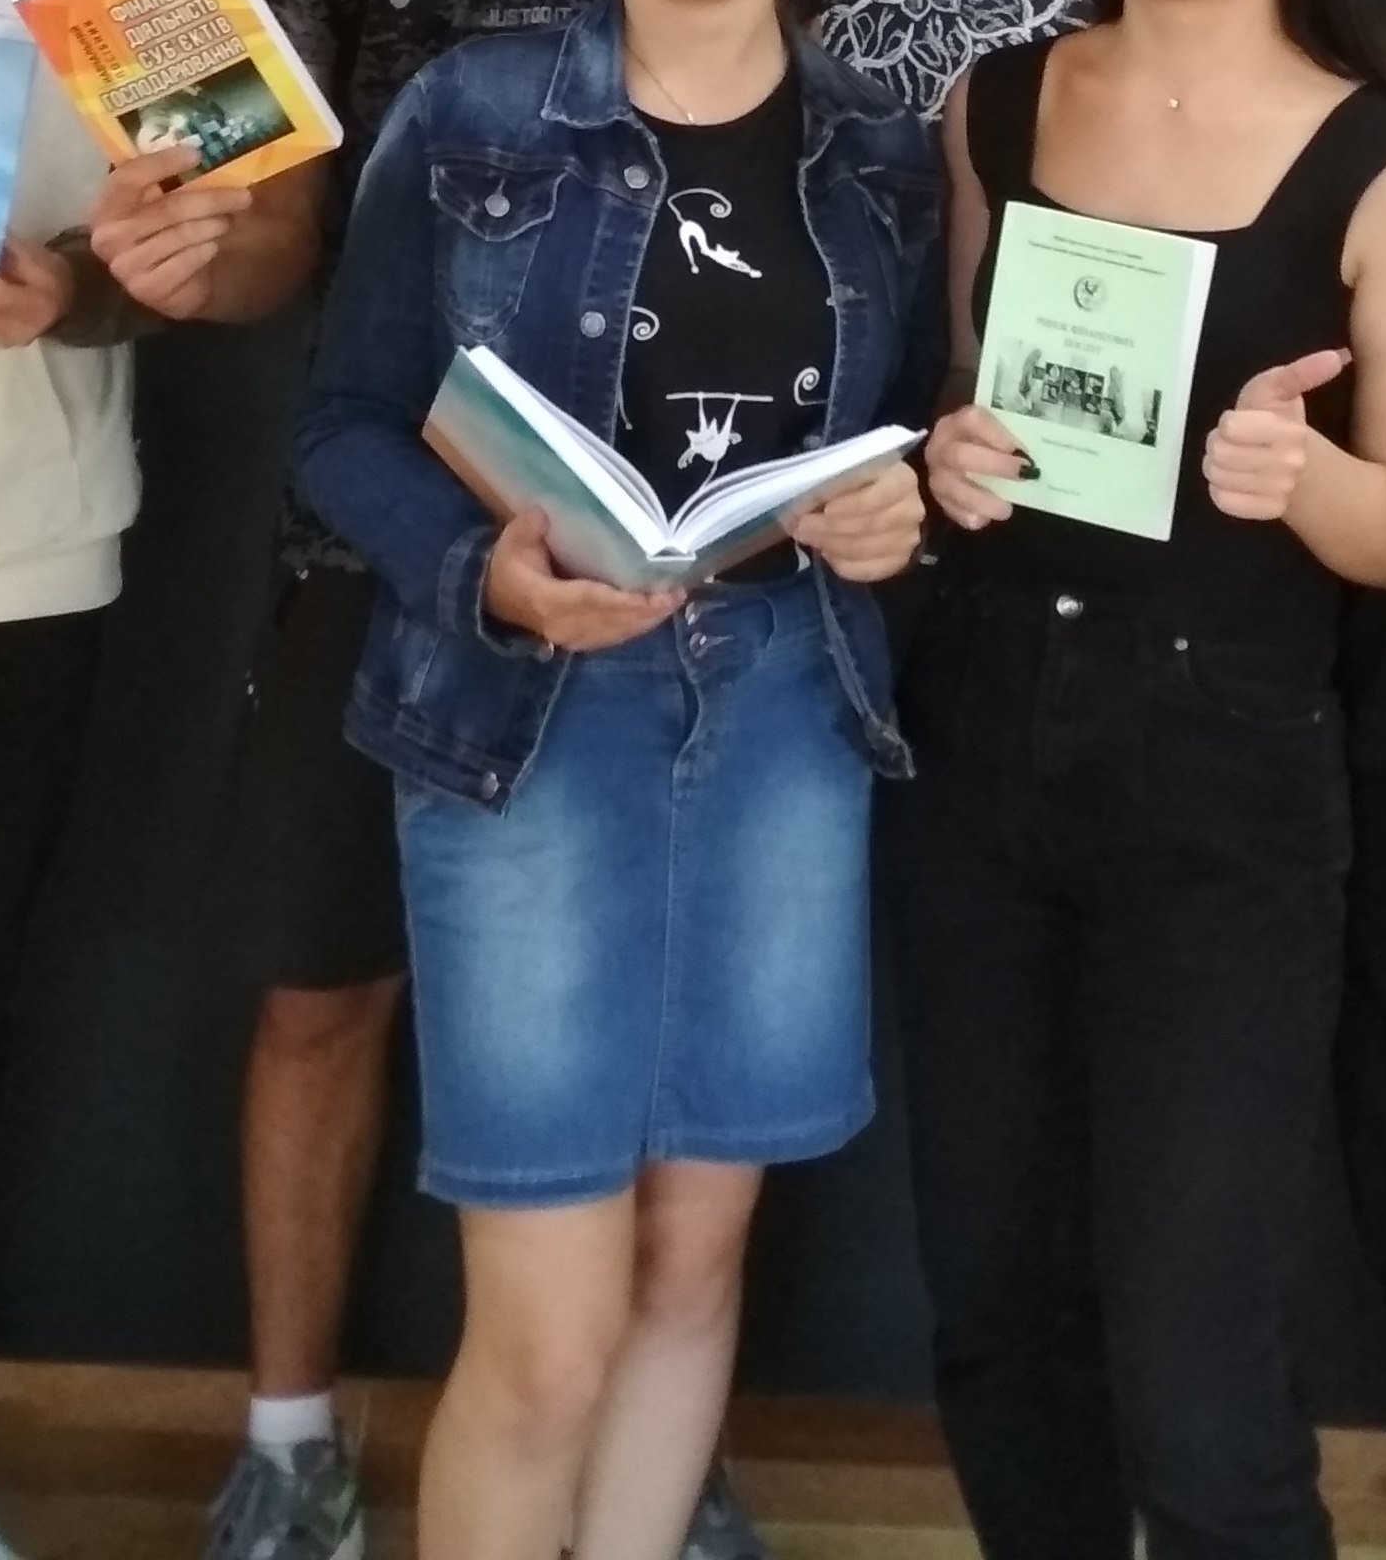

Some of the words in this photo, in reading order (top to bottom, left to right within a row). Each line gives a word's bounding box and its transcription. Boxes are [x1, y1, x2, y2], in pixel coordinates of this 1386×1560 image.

[481, 7, 531, 27] JUST
[554, 6, 573, 23] IT
[100, 35, 247, 112] ГОСПОДАРЮВАННЯ
